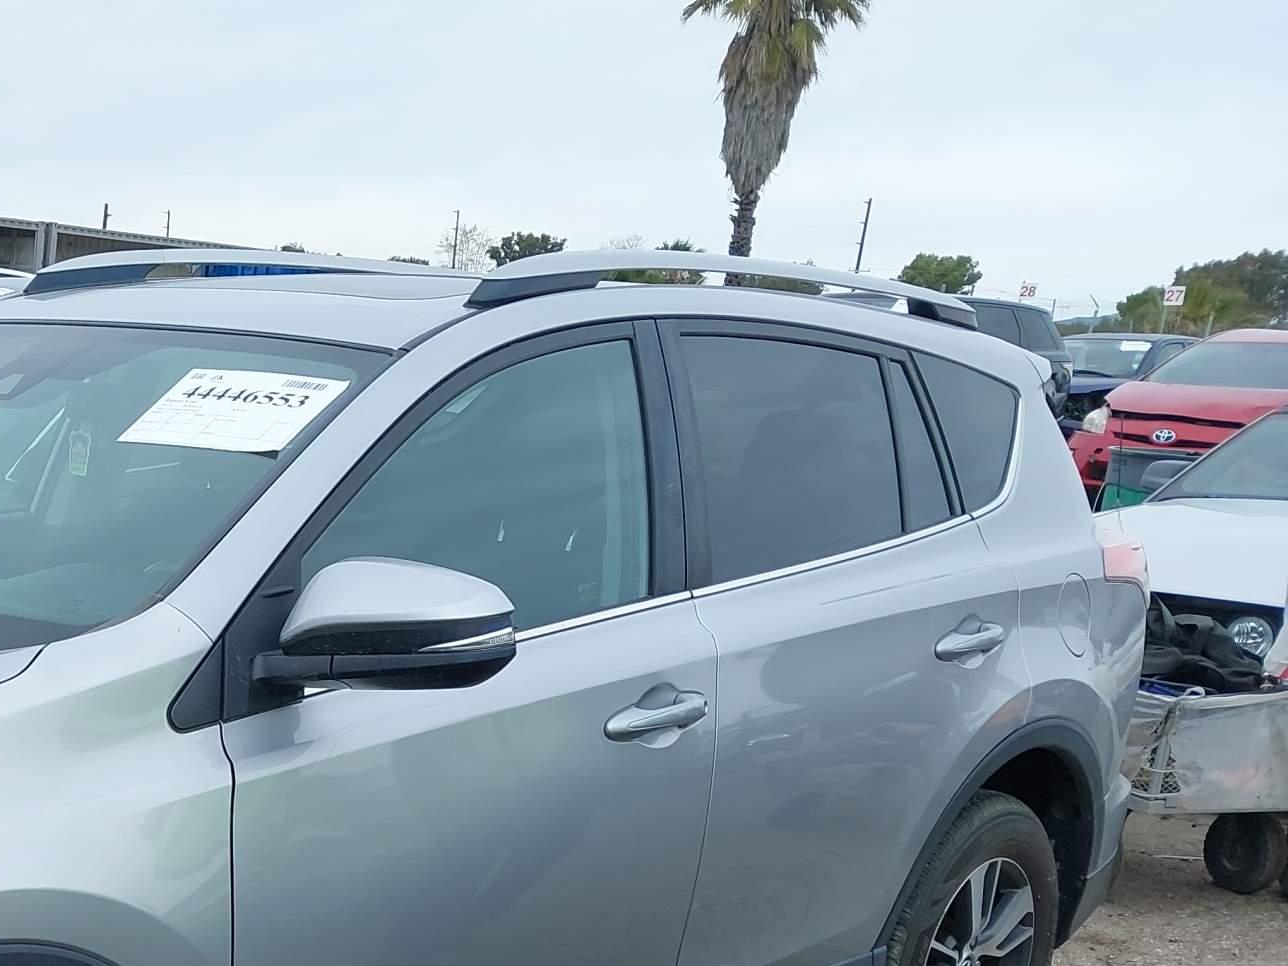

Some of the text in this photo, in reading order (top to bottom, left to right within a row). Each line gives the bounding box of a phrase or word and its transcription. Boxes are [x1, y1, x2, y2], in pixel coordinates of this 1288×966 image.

[1020, 286, 1037, 297] 28
[1165, 290, 1184, 302] 27
[182, 386, 311, 408] 44446553
